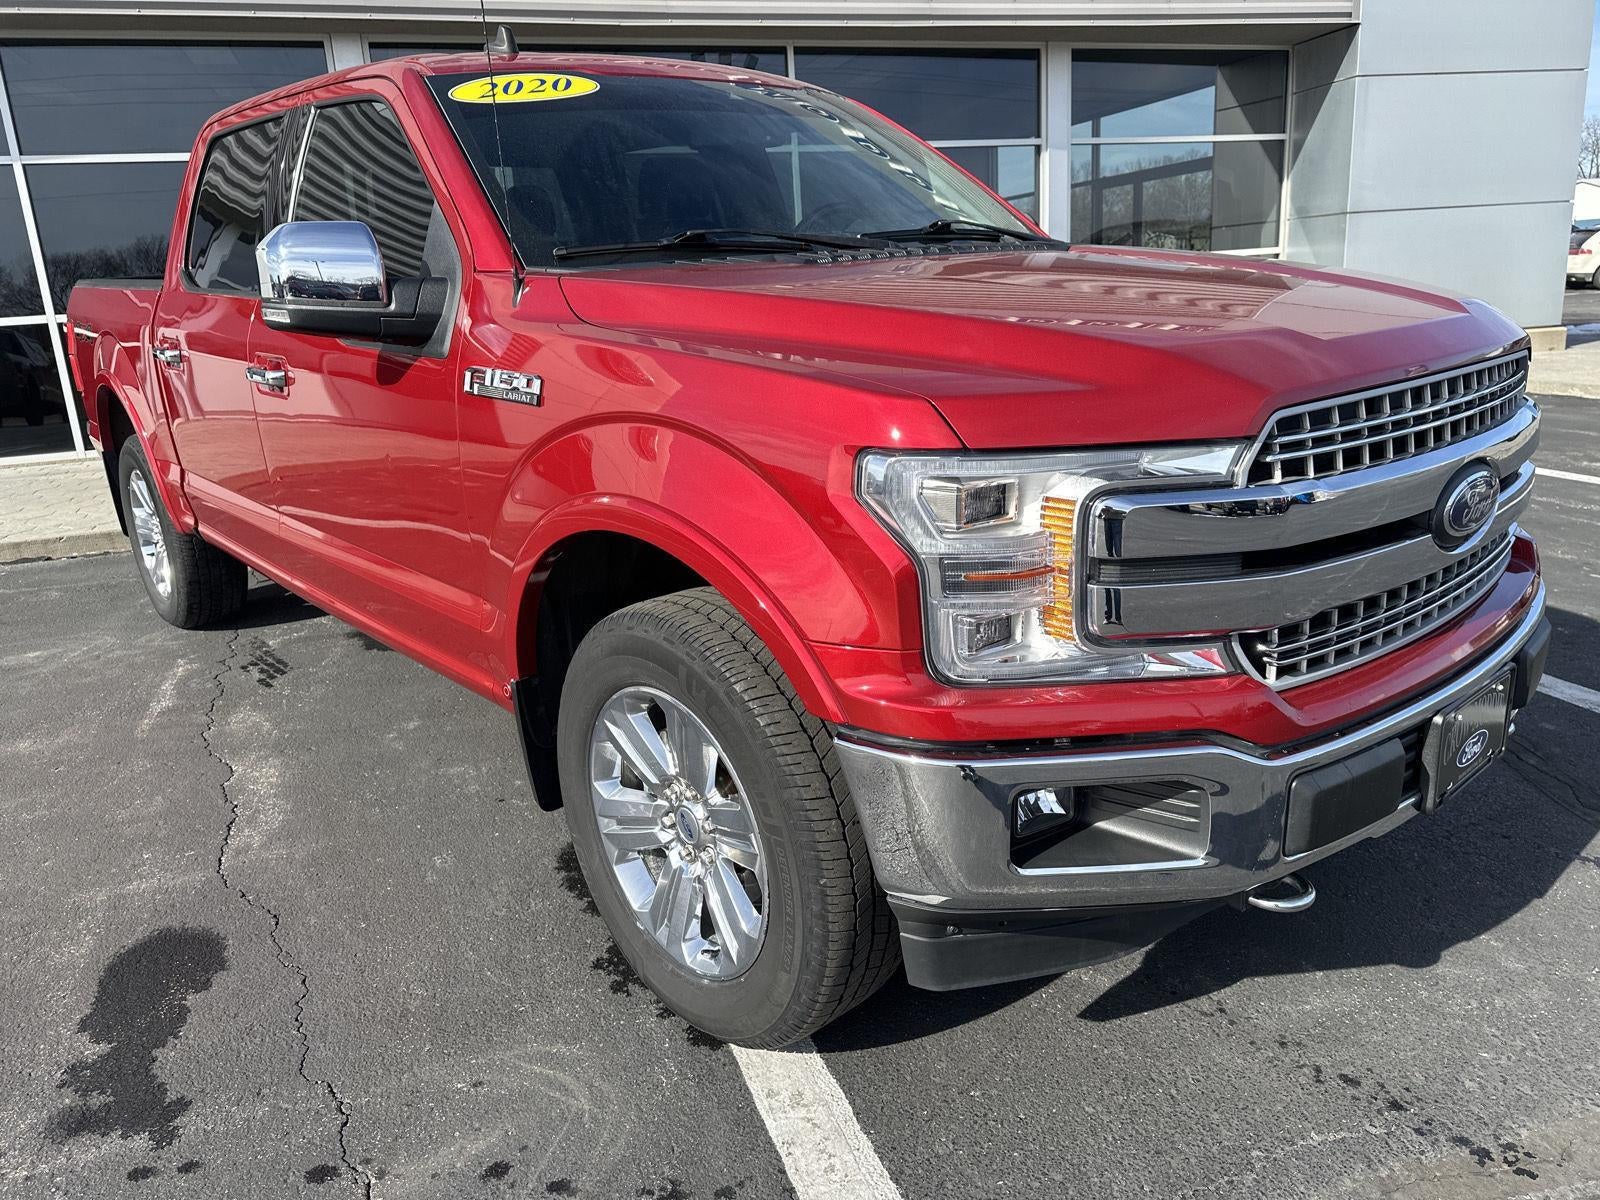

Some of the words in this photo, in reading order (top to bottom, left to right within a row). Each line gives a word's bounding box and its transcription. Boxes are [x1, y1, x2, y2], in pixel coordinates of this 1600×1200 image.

[478, 77, 572, 99] 2020
[502, 390, 532, 403] LARIAT
[776, 847, 793, 913] DEFENDER
